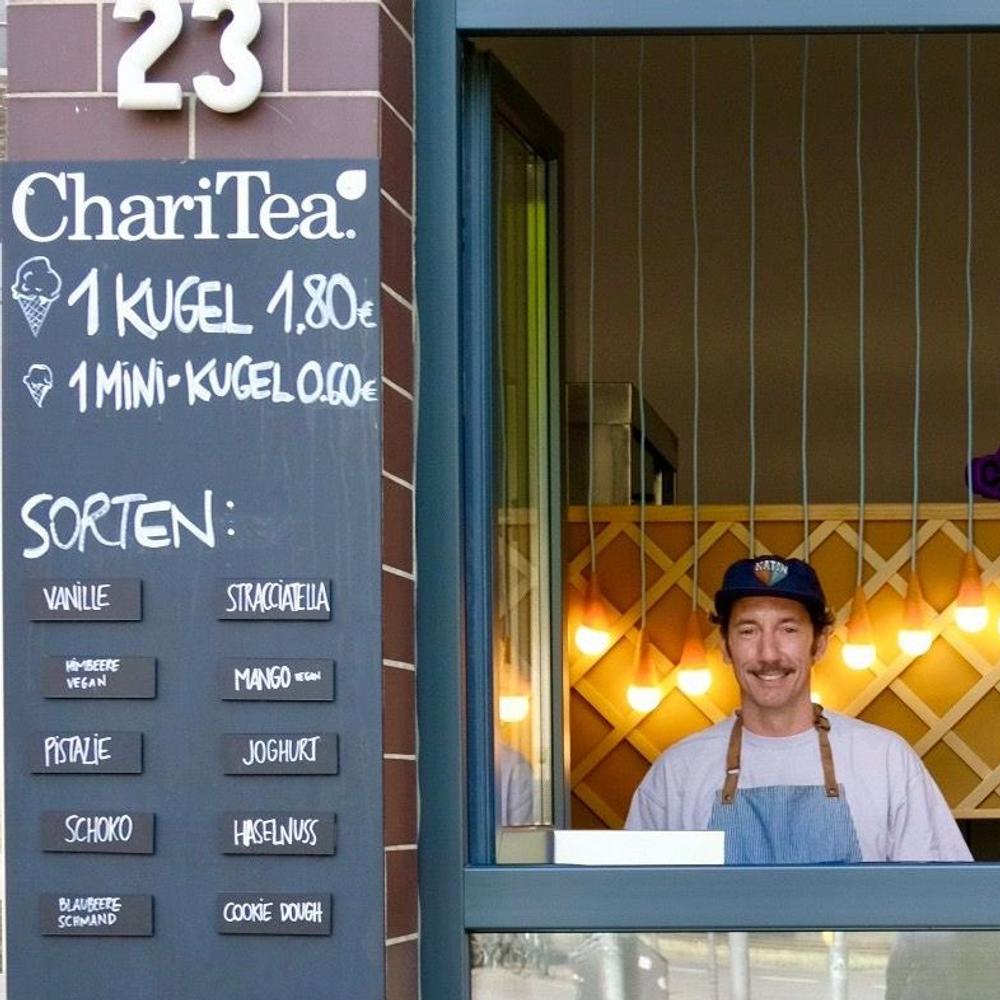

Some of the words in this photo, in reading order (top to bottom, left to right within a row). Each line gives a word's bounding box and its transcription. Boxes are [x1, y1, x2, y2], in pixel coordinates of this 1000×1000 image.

[112, 0, 263, 114] 23
[68, 268, 99, 336] 1
[116, 273, 253, 340] KUGEL
[69, 360, 87, 413] 1
[43, 581, 112, 612] VANILLE
[226, 579, 331, 613] STRACCIATELLA
[66, 674, 107, 690] VEGAN
[234, 666, 291, 691] MANGO
[243, 735, 321, 766] JOGHURT
[64, 815, 133, 843] SCHOKO
[233, 817, 319, 847] HASELNUSS
[58, 912, 117, 929] SCHMAND
[223, 898, 273, 923] COOKIE
[280, 901, 323, 923] DOUGH
